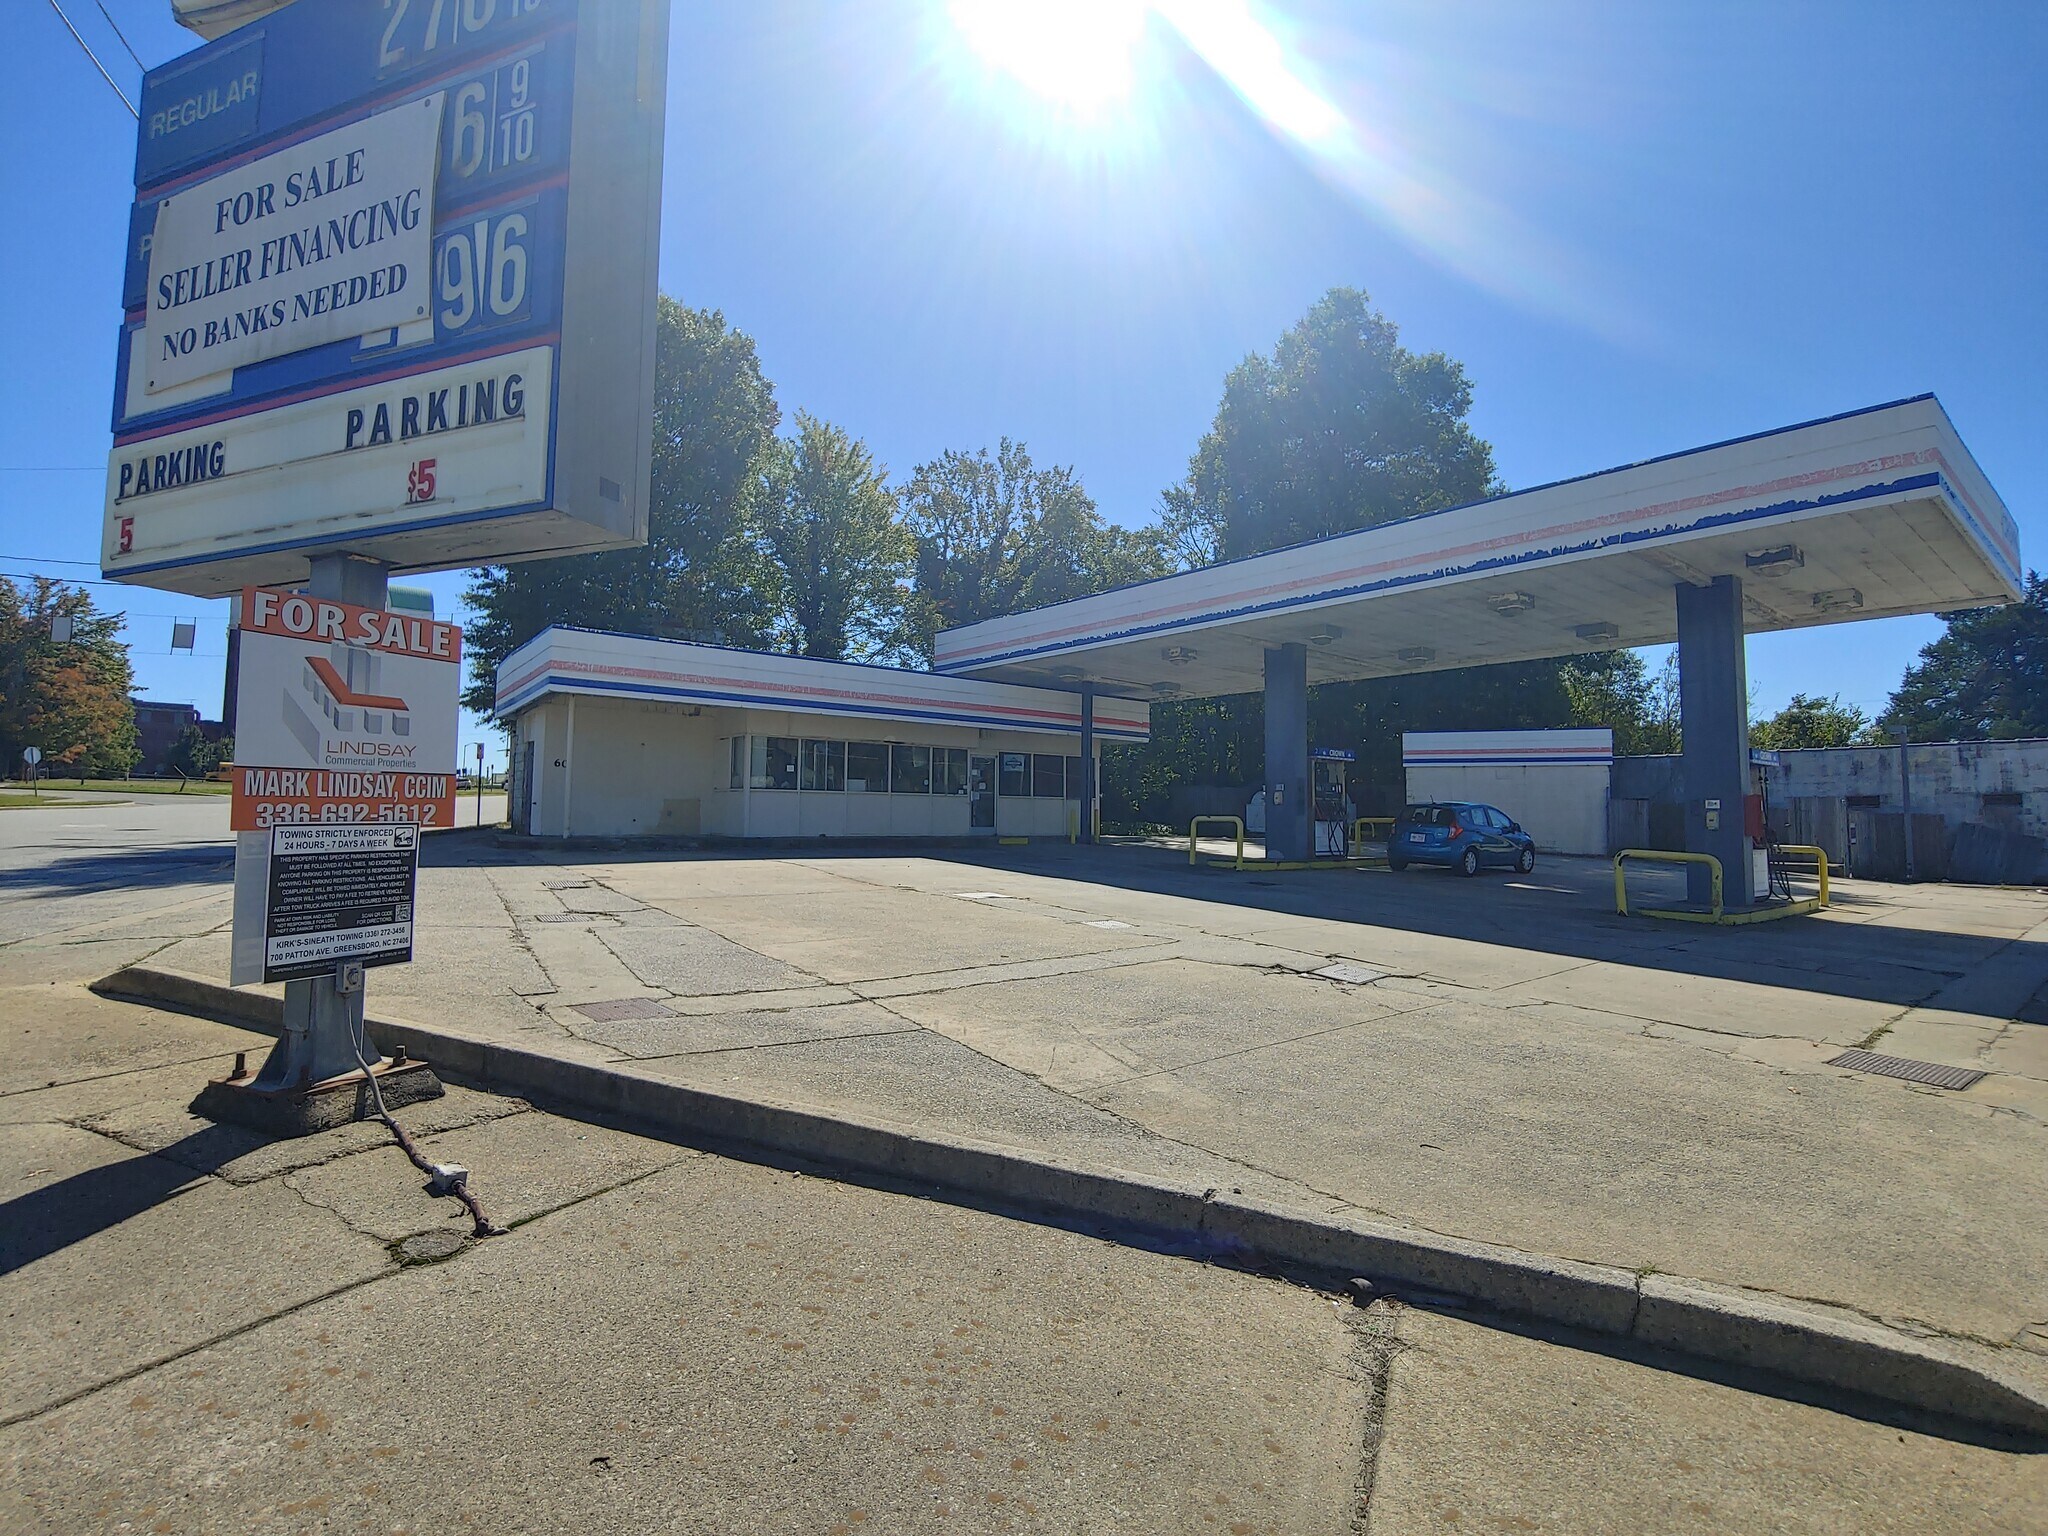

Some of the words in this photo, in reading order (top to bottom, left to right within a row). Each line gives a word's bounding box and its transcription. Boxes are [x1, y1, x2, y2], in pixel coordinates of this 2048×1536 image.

[149, 71, 258, 140] REGULAR
[214, 182, 276, 234] FOR
[284, 148, 365, 209] SALE
[157, 248, 253, 311] SELLER
[258, 188, 422, 281] FINANCING
[162, 327, 198, 361] NO
[203, 299, 287, 349] BANKS
[291, 263, 408, 323] NEEDED
[119, 441, 225, 499] PARKING
[345, 373, 525, 449] PARKING
[120, 518, 134, 552] 5
[253, 591, 347, 641] FOR
[357, 611, 452, 657] SALE
[325, 755, 376, 767] Commercial
[377, 757, 417, 769] Properties
[326, 740, 418, 758] LINDSAY
[244, 770, 311, 798] MARK
[316, 772, 400, 803] LINDSAY,
[404, 775, 447, 799] CCIM
[255, 801, 438, 828] 336-692-5612
[279, 830, 313, 839] TOWING
[315, 829, 352, 838] STRICTLY
[354, 828, 394, 837] ENFORCED
[284, 841, 294, 850] 24
[296, 840, 325, 850] HOURS
[331, 840, 336, 849] 7
[338, 840, 359, 849] DAYS
[359, 839, 366, 848] A
[366, 838, 388, 847] WEEK
[270, 952, 284, 962] 700
[285, 949, 315, 960] PATTON
[383, 938, 392, 947] NC
[276, 936, 336, 949] KIRK'S-SINEATH
[336, 931, 364, 942] TOWING
